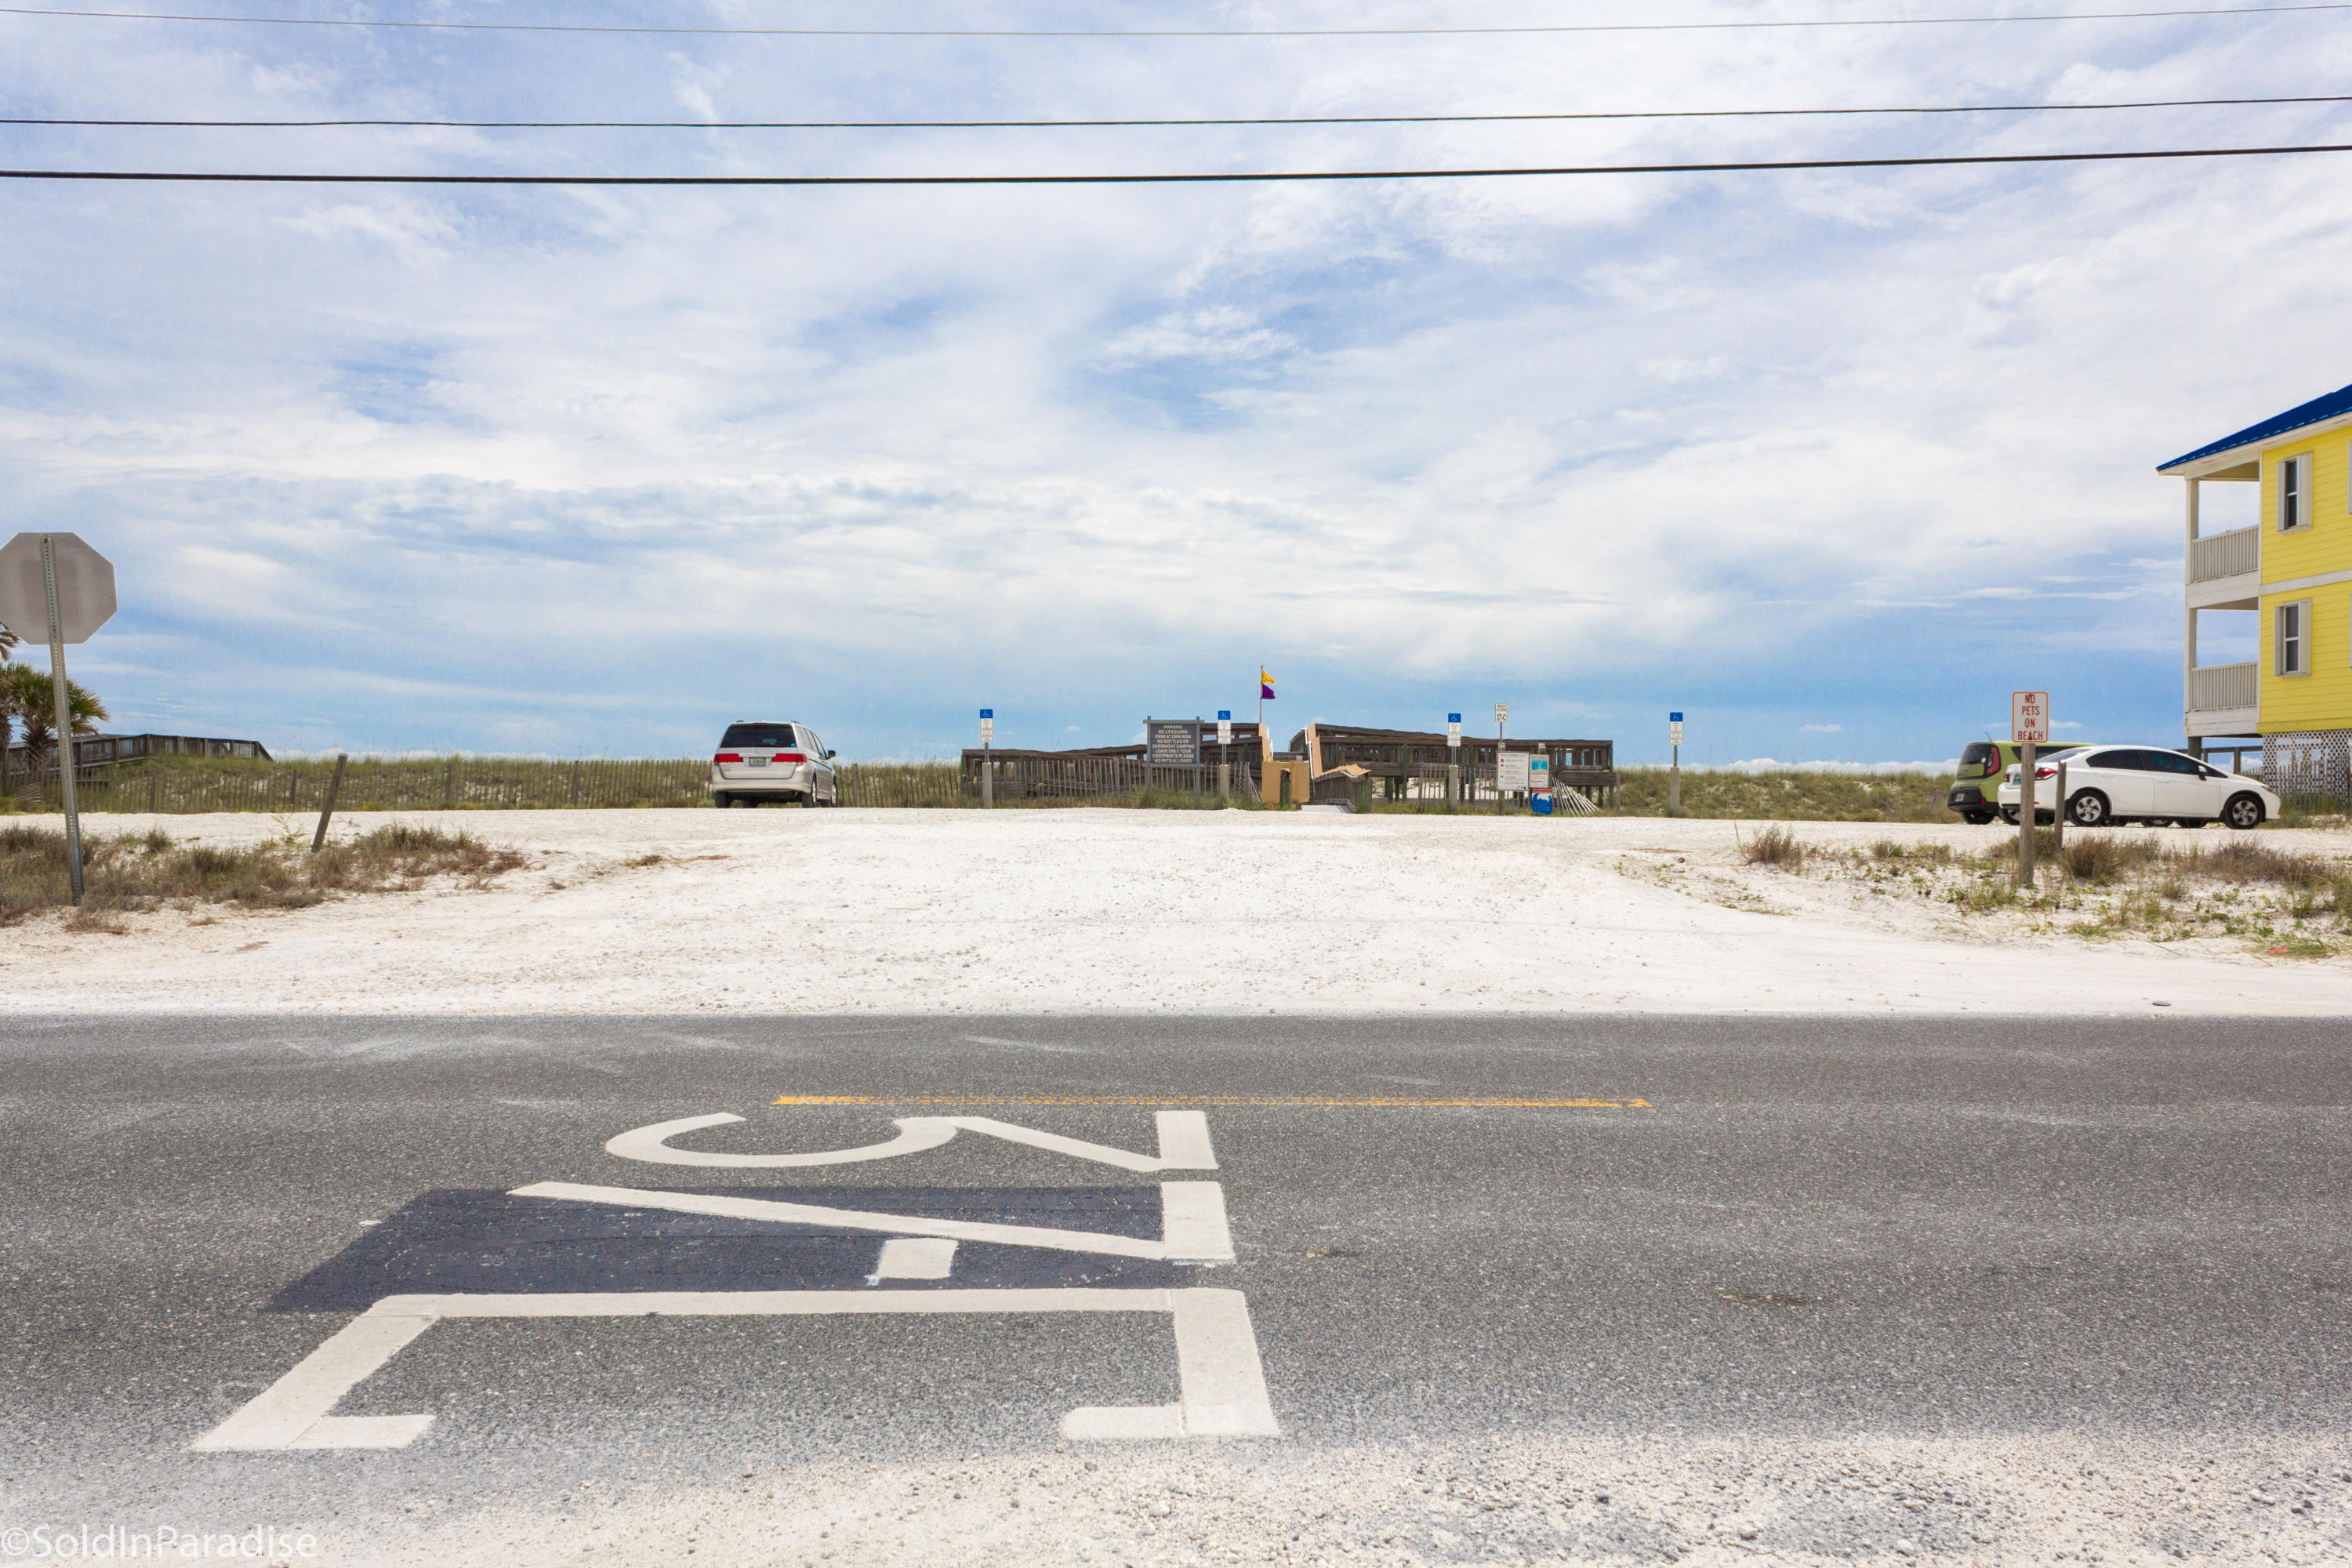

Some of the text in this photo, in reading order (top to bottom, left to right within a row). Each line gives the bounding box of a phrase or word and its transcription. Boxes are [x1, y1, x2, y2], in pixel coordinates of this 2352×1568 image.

[2025, 694, 2035, 703] NO
[2021, 706, 2040, 715] PETS
[2025, 718, 2035, 728] ON
[2018, 731, 2043, 741] BEACH
